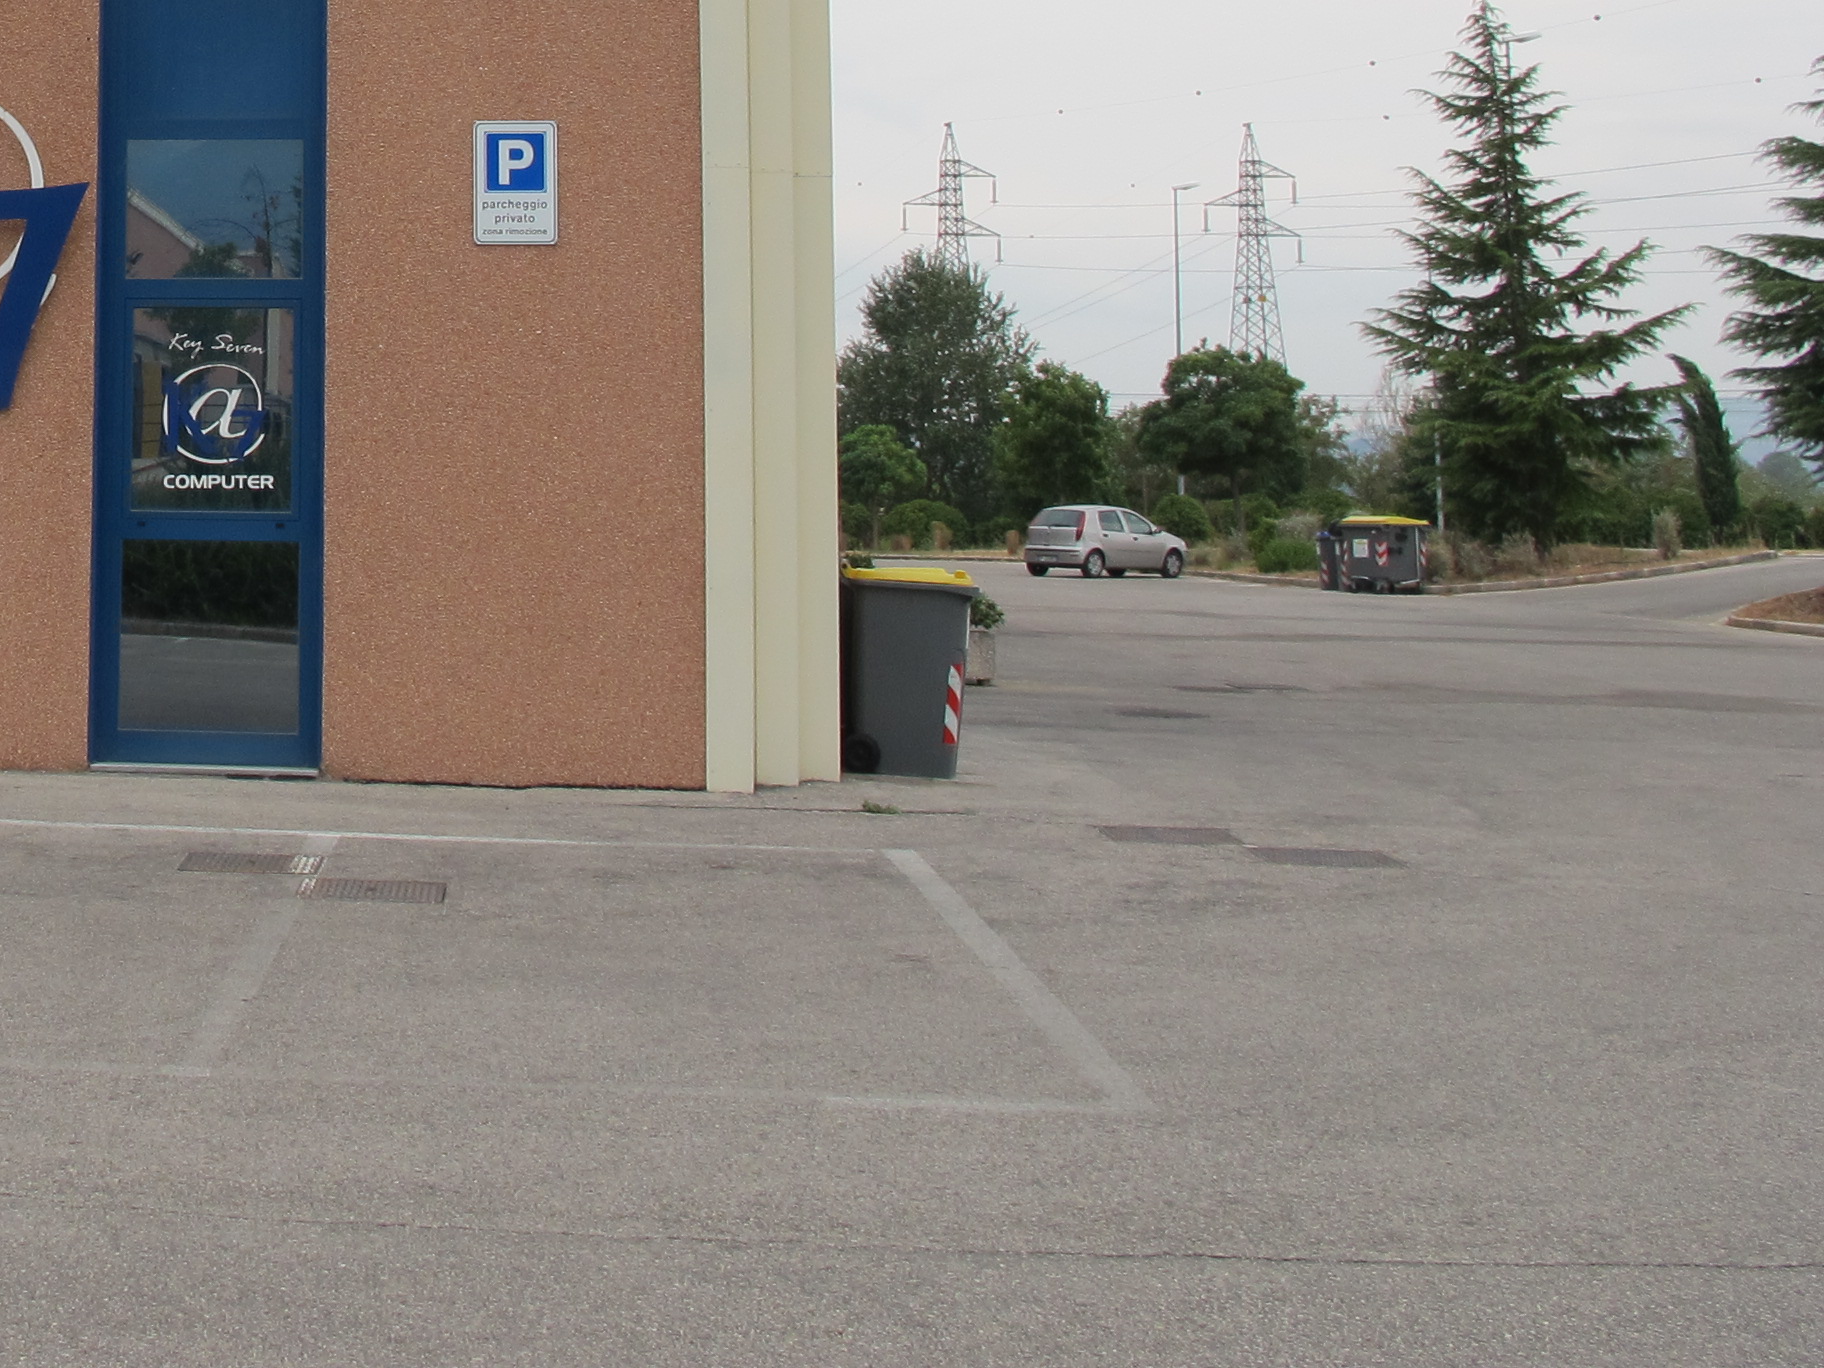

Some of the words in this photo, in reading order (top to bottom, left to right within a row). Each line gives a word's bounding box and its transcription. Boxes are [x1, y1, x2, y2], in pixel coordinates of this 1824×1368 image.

[498, 138, 535, 186] P
[481, 199, 548, 211] parcheggio
[494, 213, 536, 224] privato
[481, 228, 504, 236] zona
[505, 227, 548, 236] rimozione
[168, 332, 205, 359] Key
[210, 333, 267, 355] Seven
[163, 474, 275, 490] COMPUTER
